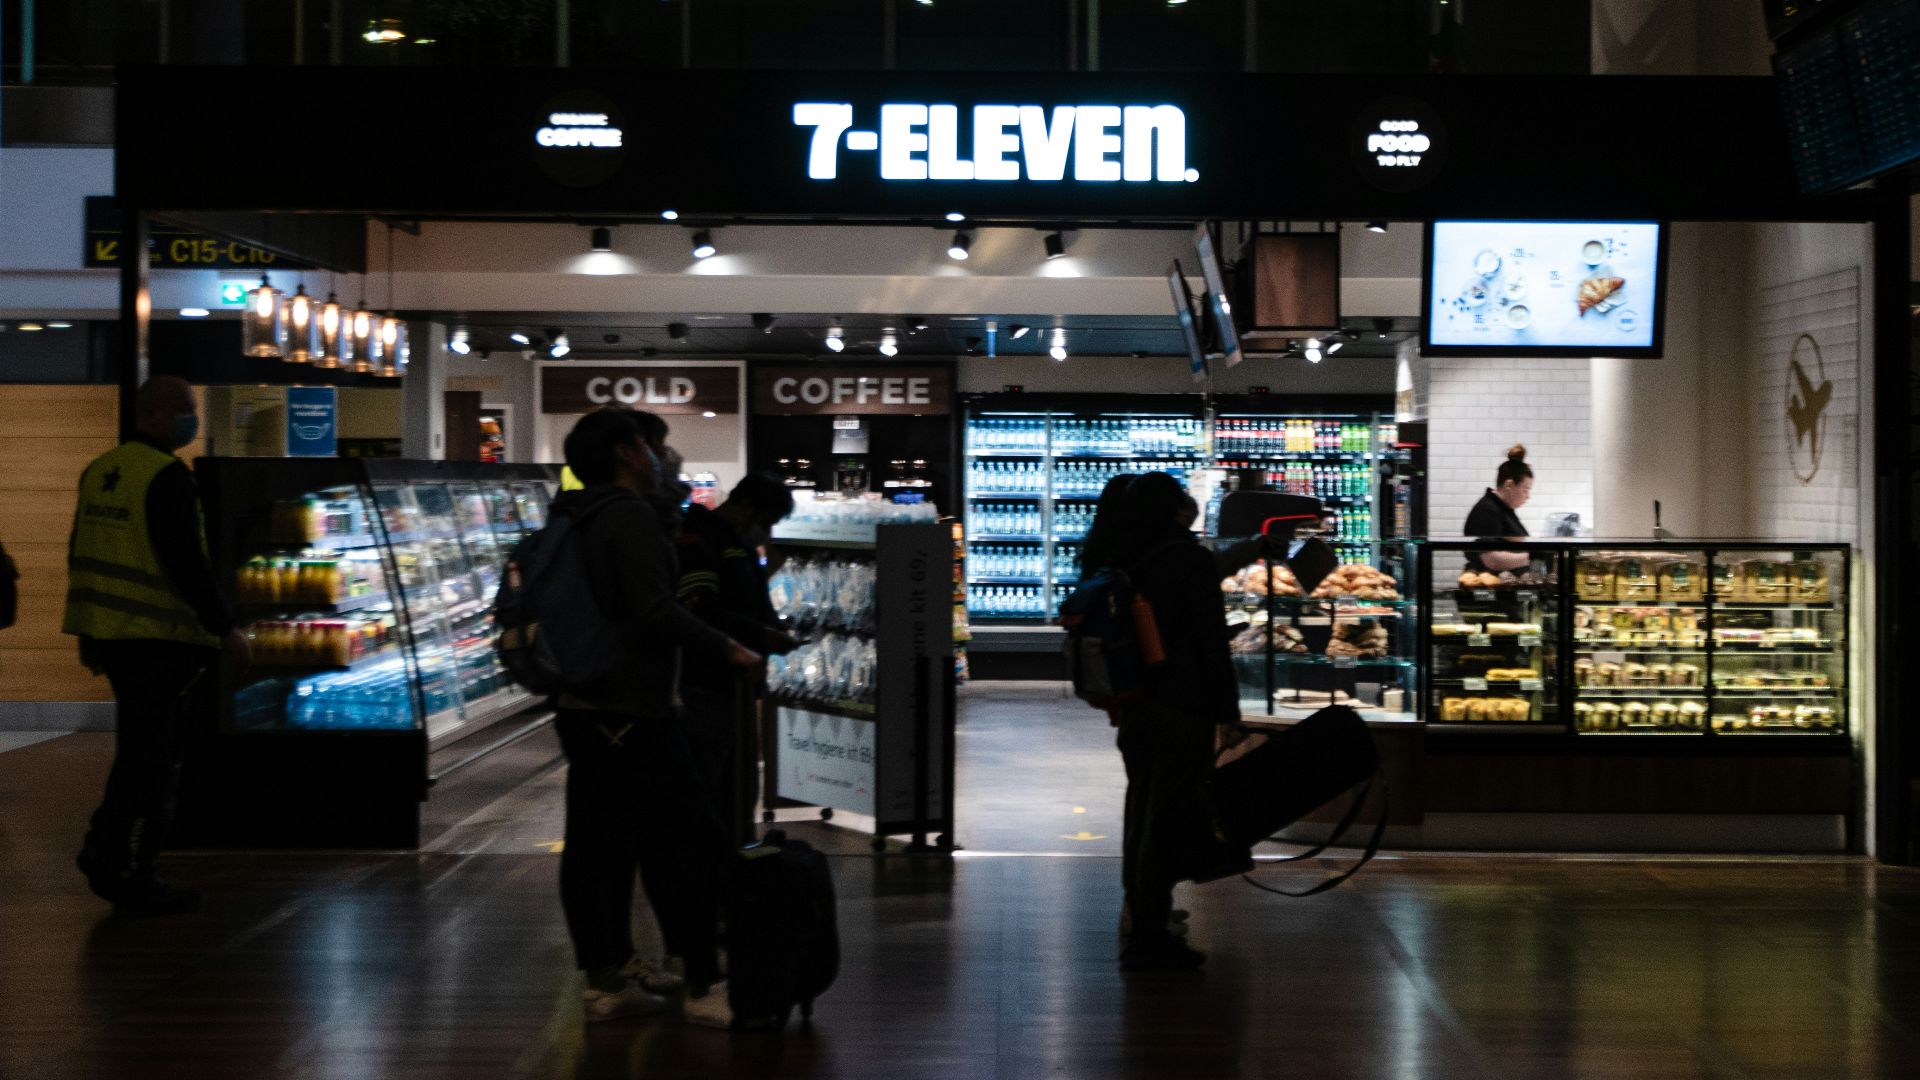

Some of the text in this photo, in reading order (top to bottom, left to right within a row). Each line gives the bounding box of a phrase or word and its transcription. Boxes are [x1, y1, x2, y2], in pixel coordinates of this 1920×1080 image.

[536, 127, 622, 147] COFFEE
[1367, 133, 1431, 153] FOOD
[585, 376, 696, 404] COLD
[772, 377, 930, 404] COFFEE
